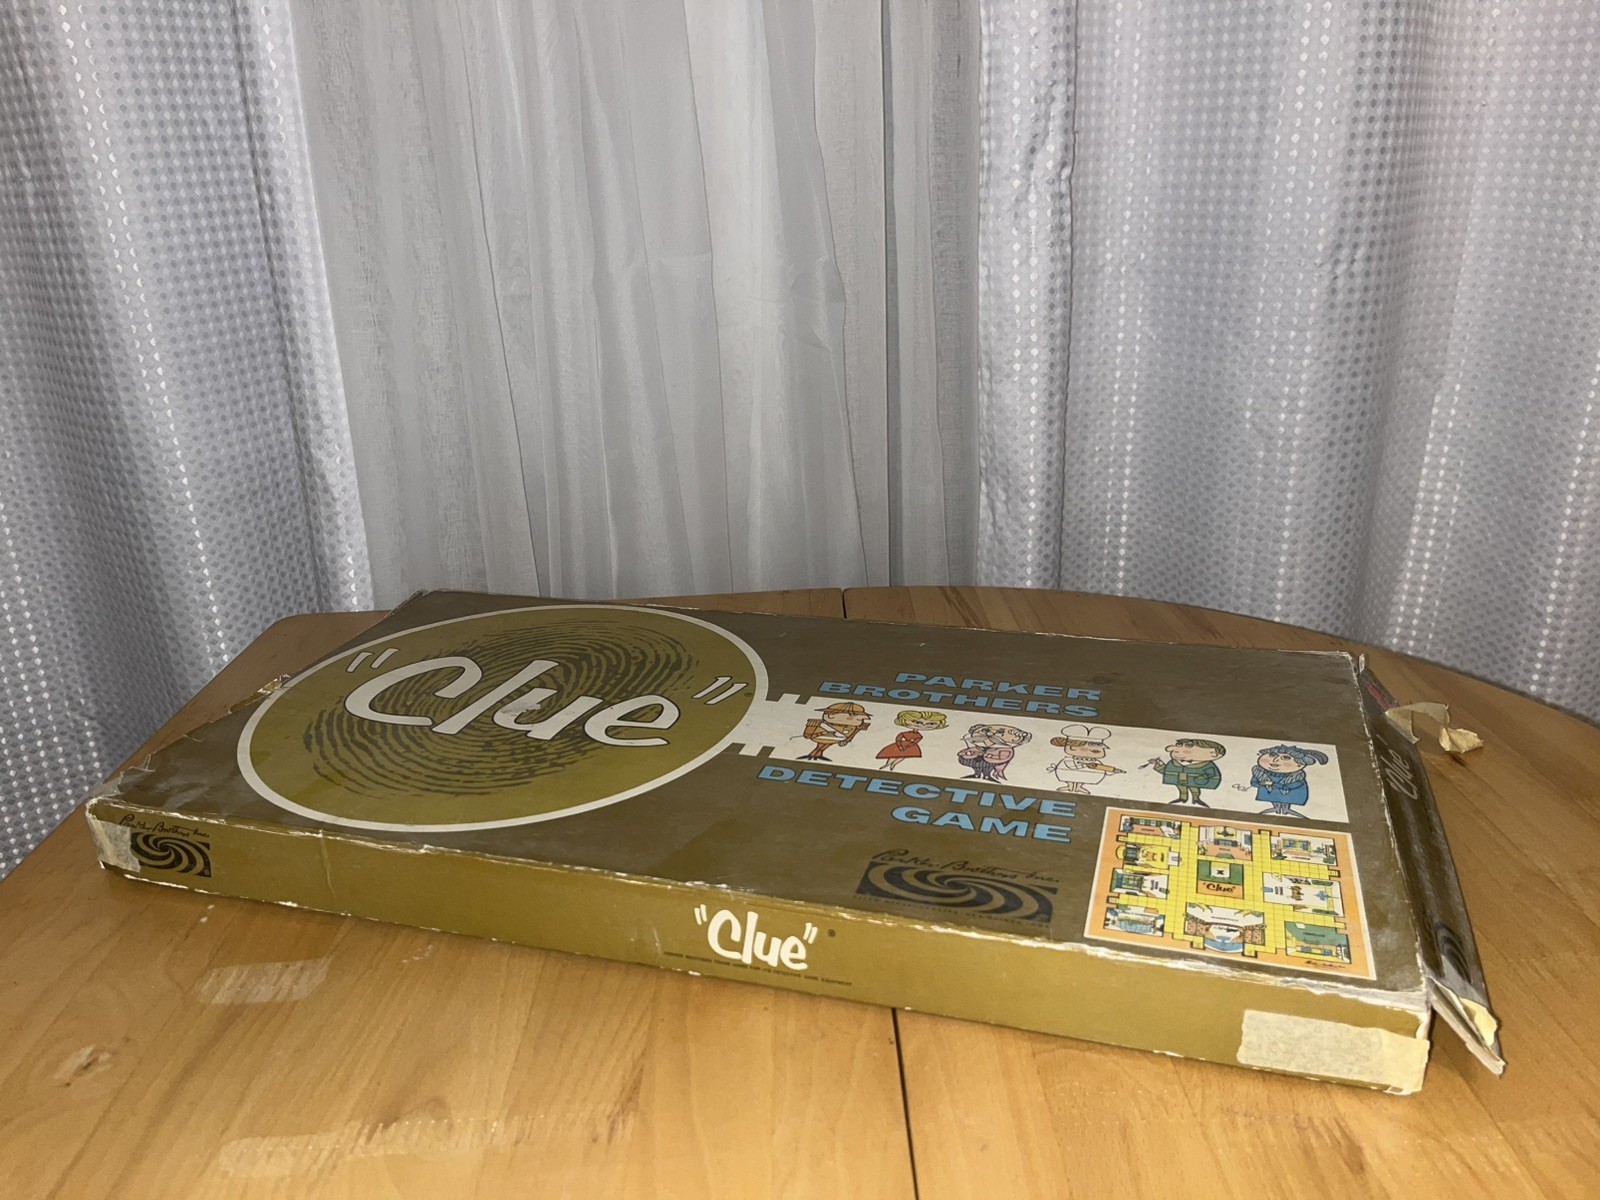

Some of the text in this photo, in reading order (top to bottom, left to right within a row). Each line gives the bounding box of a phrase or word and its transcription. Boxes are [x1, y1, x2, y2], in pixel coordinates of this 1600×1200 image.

[344, 647, 748, 747] "Clue"
[818, 681, 1099, 717] BROTHERS
[895, 672, 1101, 700] PARKER
[756, 764, 1077, 818] DETECTIVE
[891, 806, 1073, 843] GAME
[694, 904, 818, 971] "Clue"
